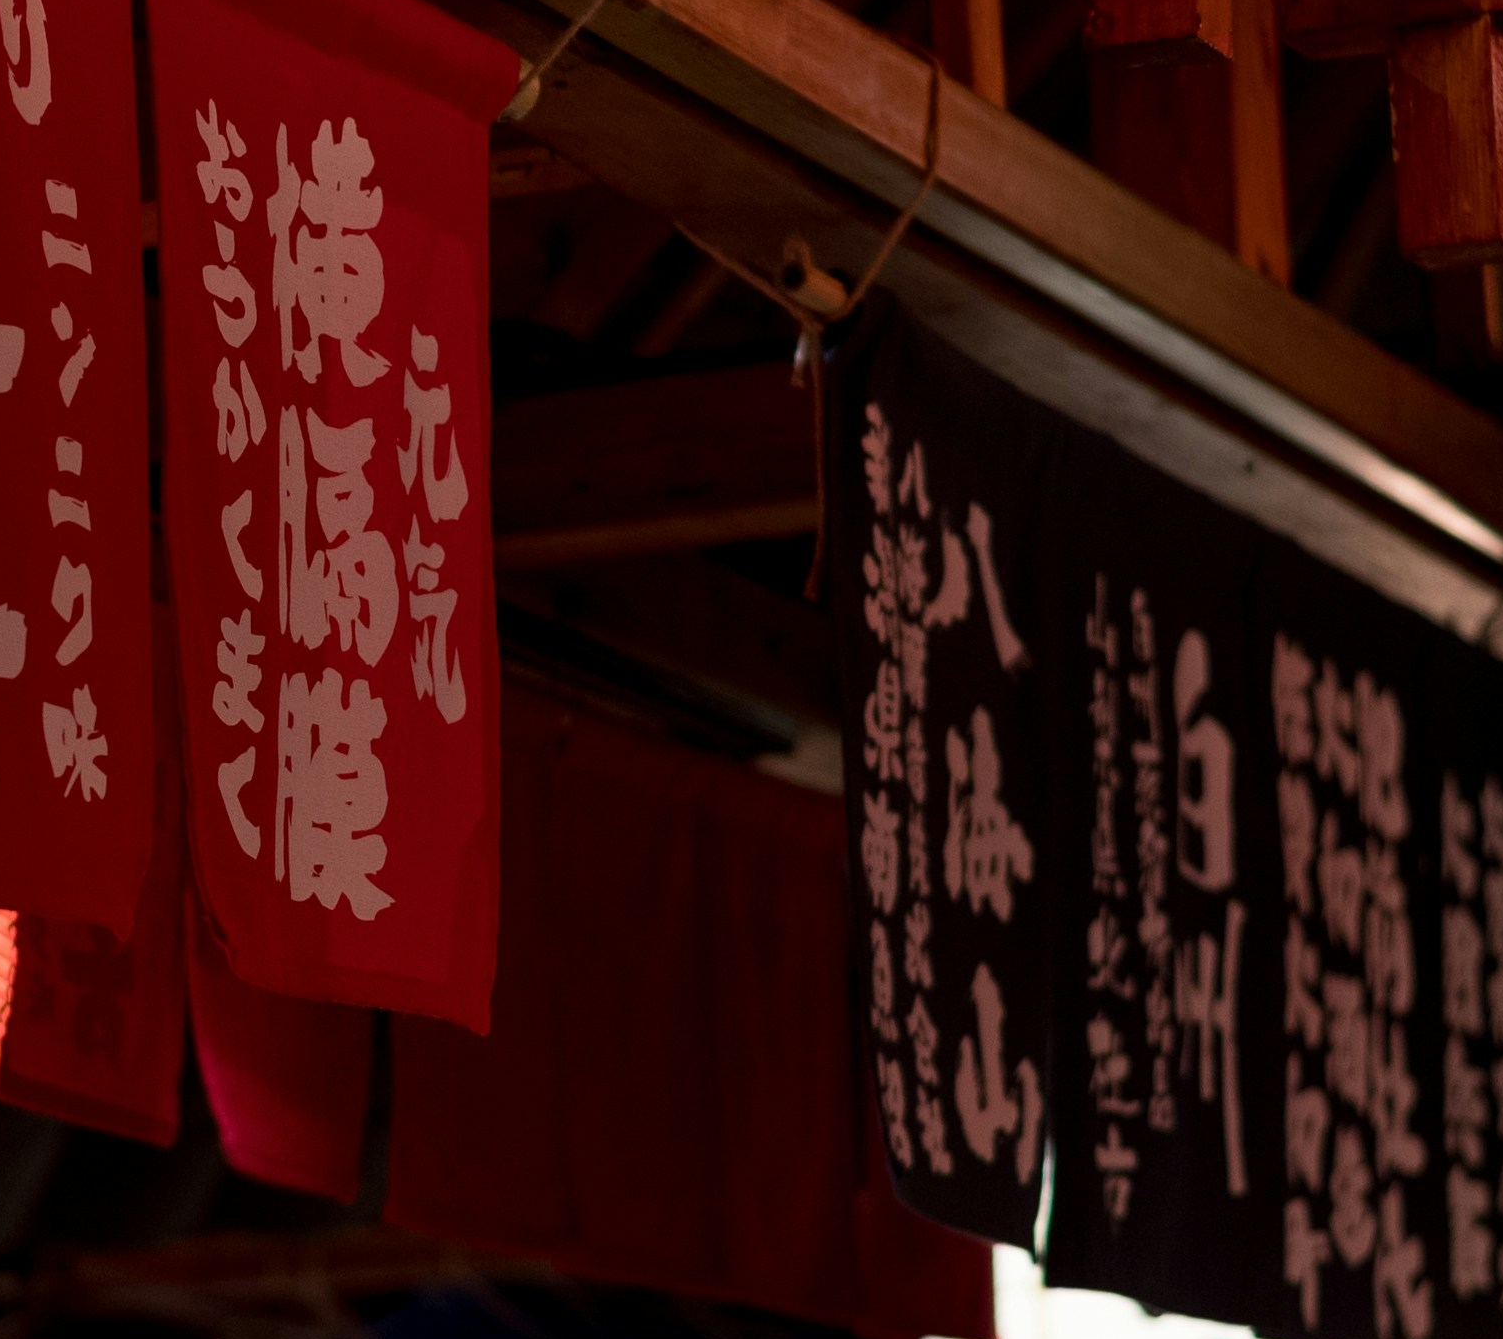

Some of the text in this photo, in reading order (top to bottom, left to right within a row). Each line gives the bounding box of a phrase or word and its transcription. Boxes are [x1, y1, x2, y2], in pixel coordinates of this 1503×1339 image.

[42, 178, 108, 803] ニンニク味
[265, 115, 399, 921] 横隔膜
[396, 324, 470, 724] 元気
[923, 498, 1045, 1189] 八海山
